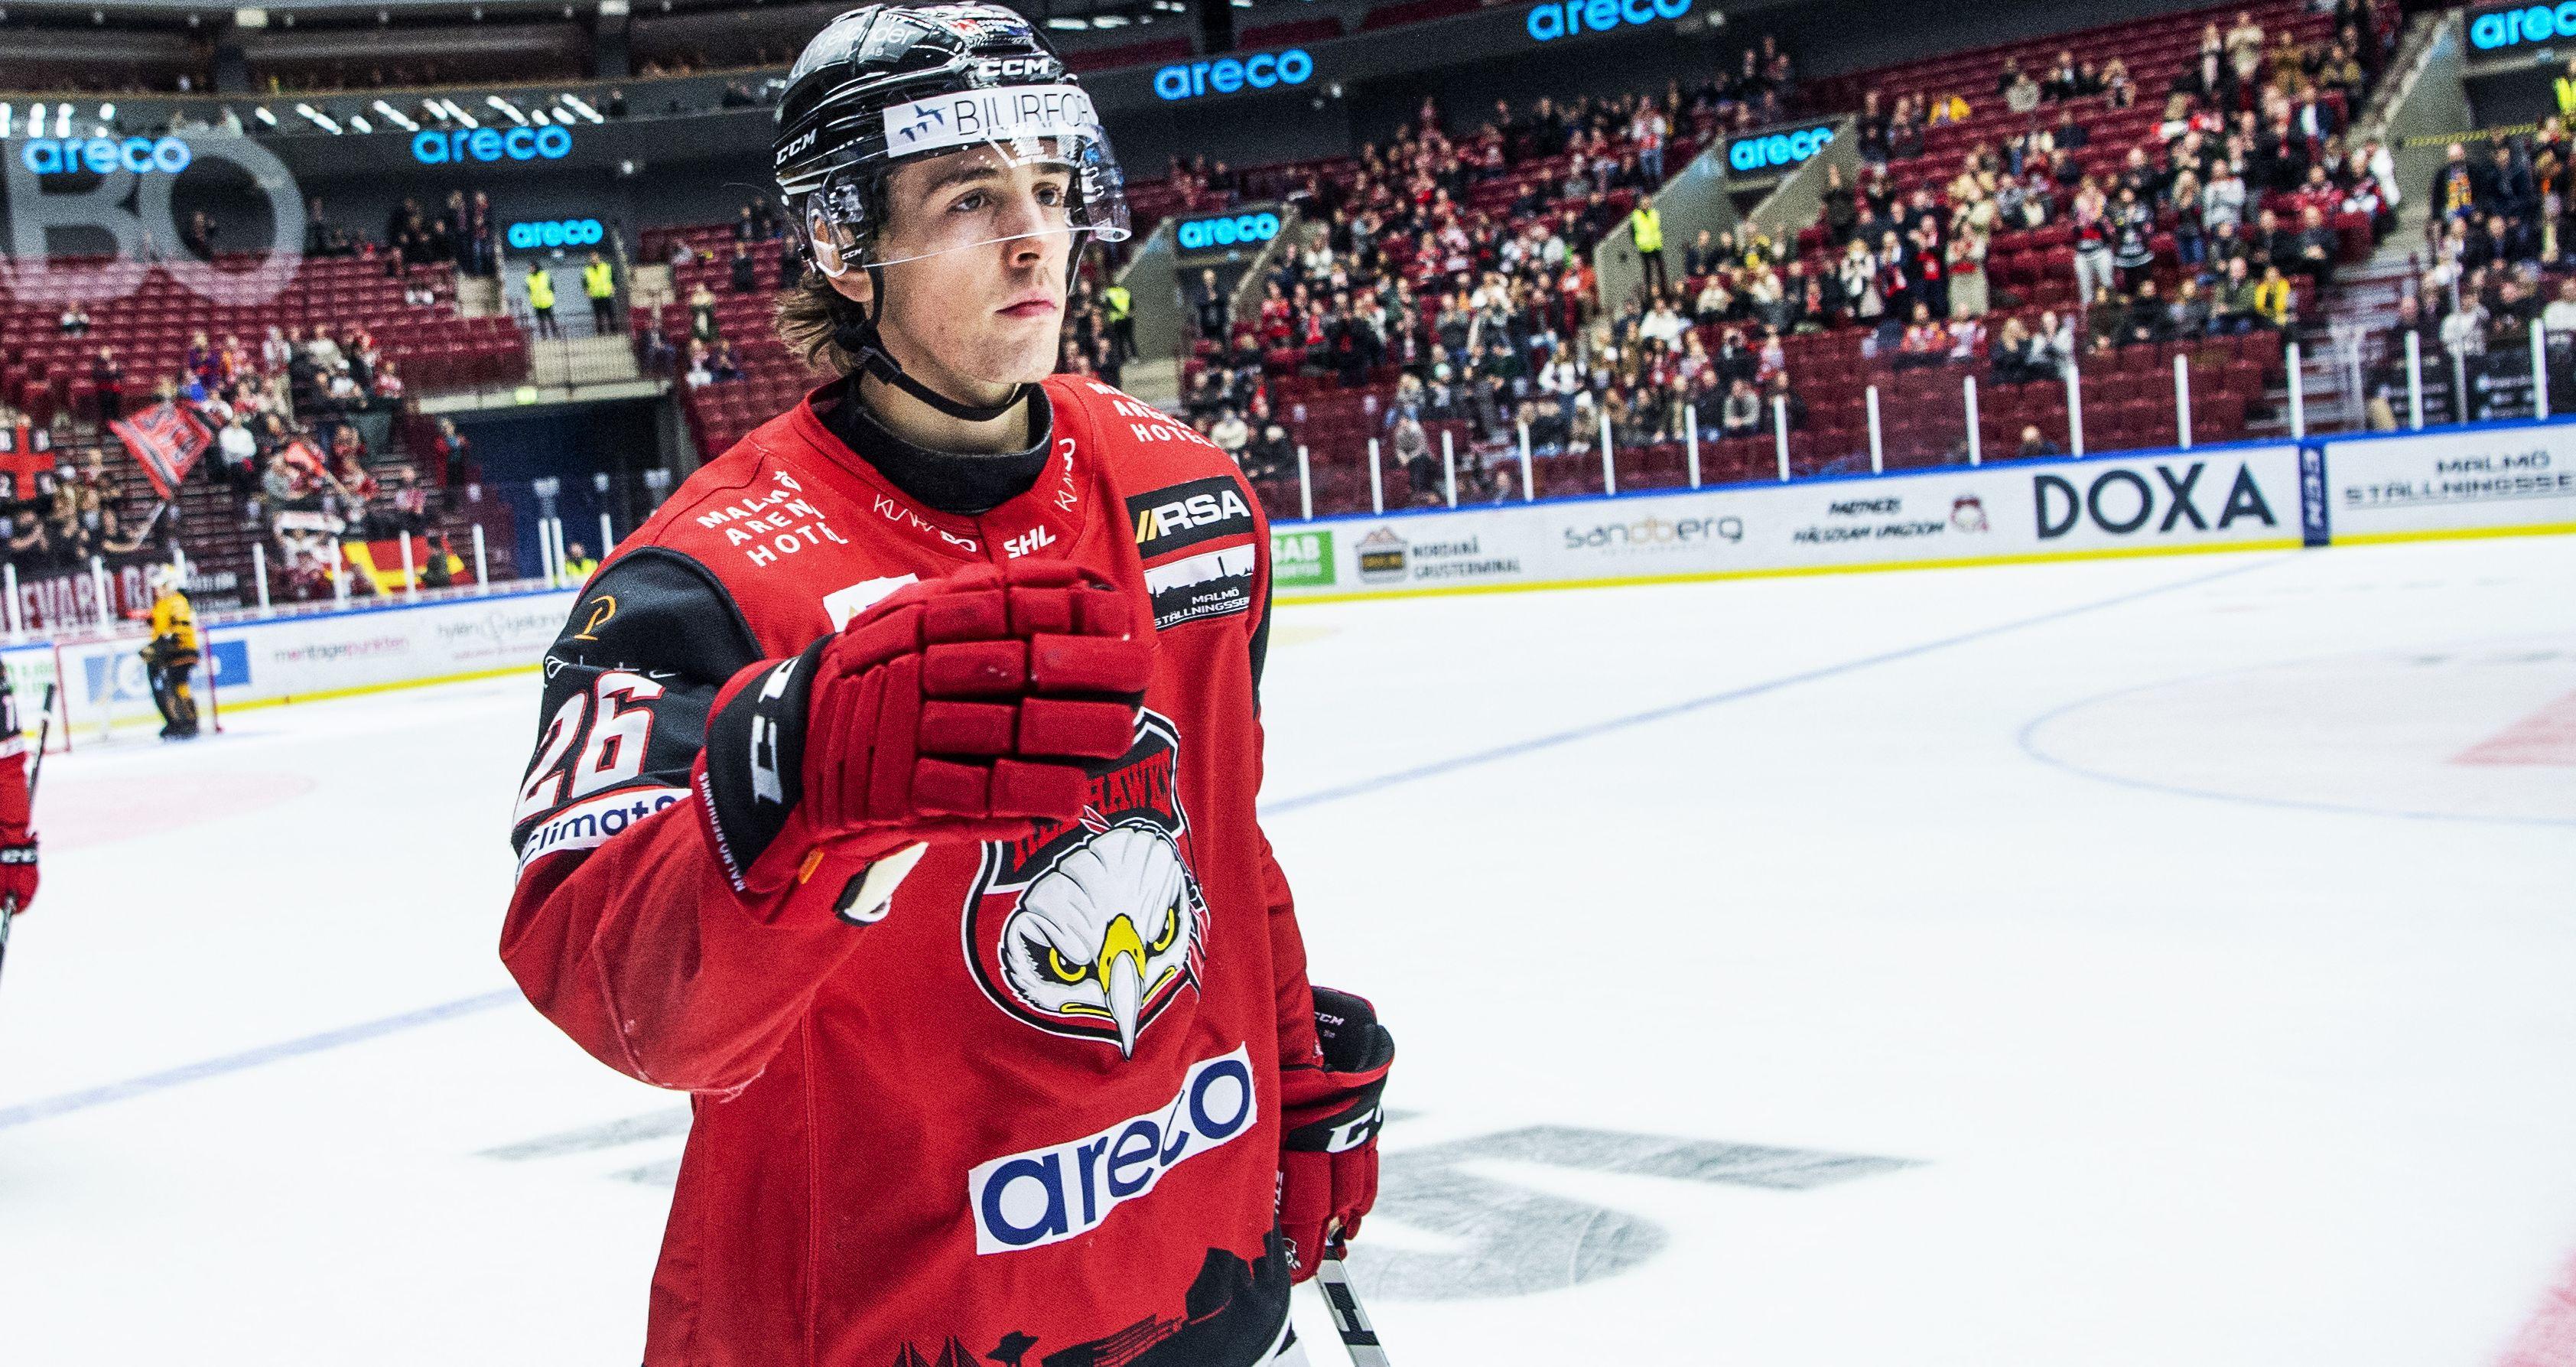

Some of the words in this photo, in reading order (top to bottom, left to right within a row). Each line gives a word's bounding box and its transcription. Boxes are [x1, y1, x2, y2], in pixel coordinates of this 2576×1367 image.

[1528, 0, 1691, 41] areco
[978, 59, 1049, 77] CCM
[1154, 49, 1312, 99] areco
[21, 136, 192, 174] areco
[412, 124, 571, 163] areco
[776, 129, 817, 166] CCM
[1730, 128, 1833, 171] areco
[508, 220, 603, 248] areco
[1179, 213, 1280, 249] areco
[841, 248, 863, 260] CCM
[2034, 463, 2277, 540] DOXA
[1003, 525, 1056, 558] SHL
[1564, 515, 1744, 550] sandberg
[1192, 587, 1240, 605] MALMÖ
[513, 671, 665, 827] 26
